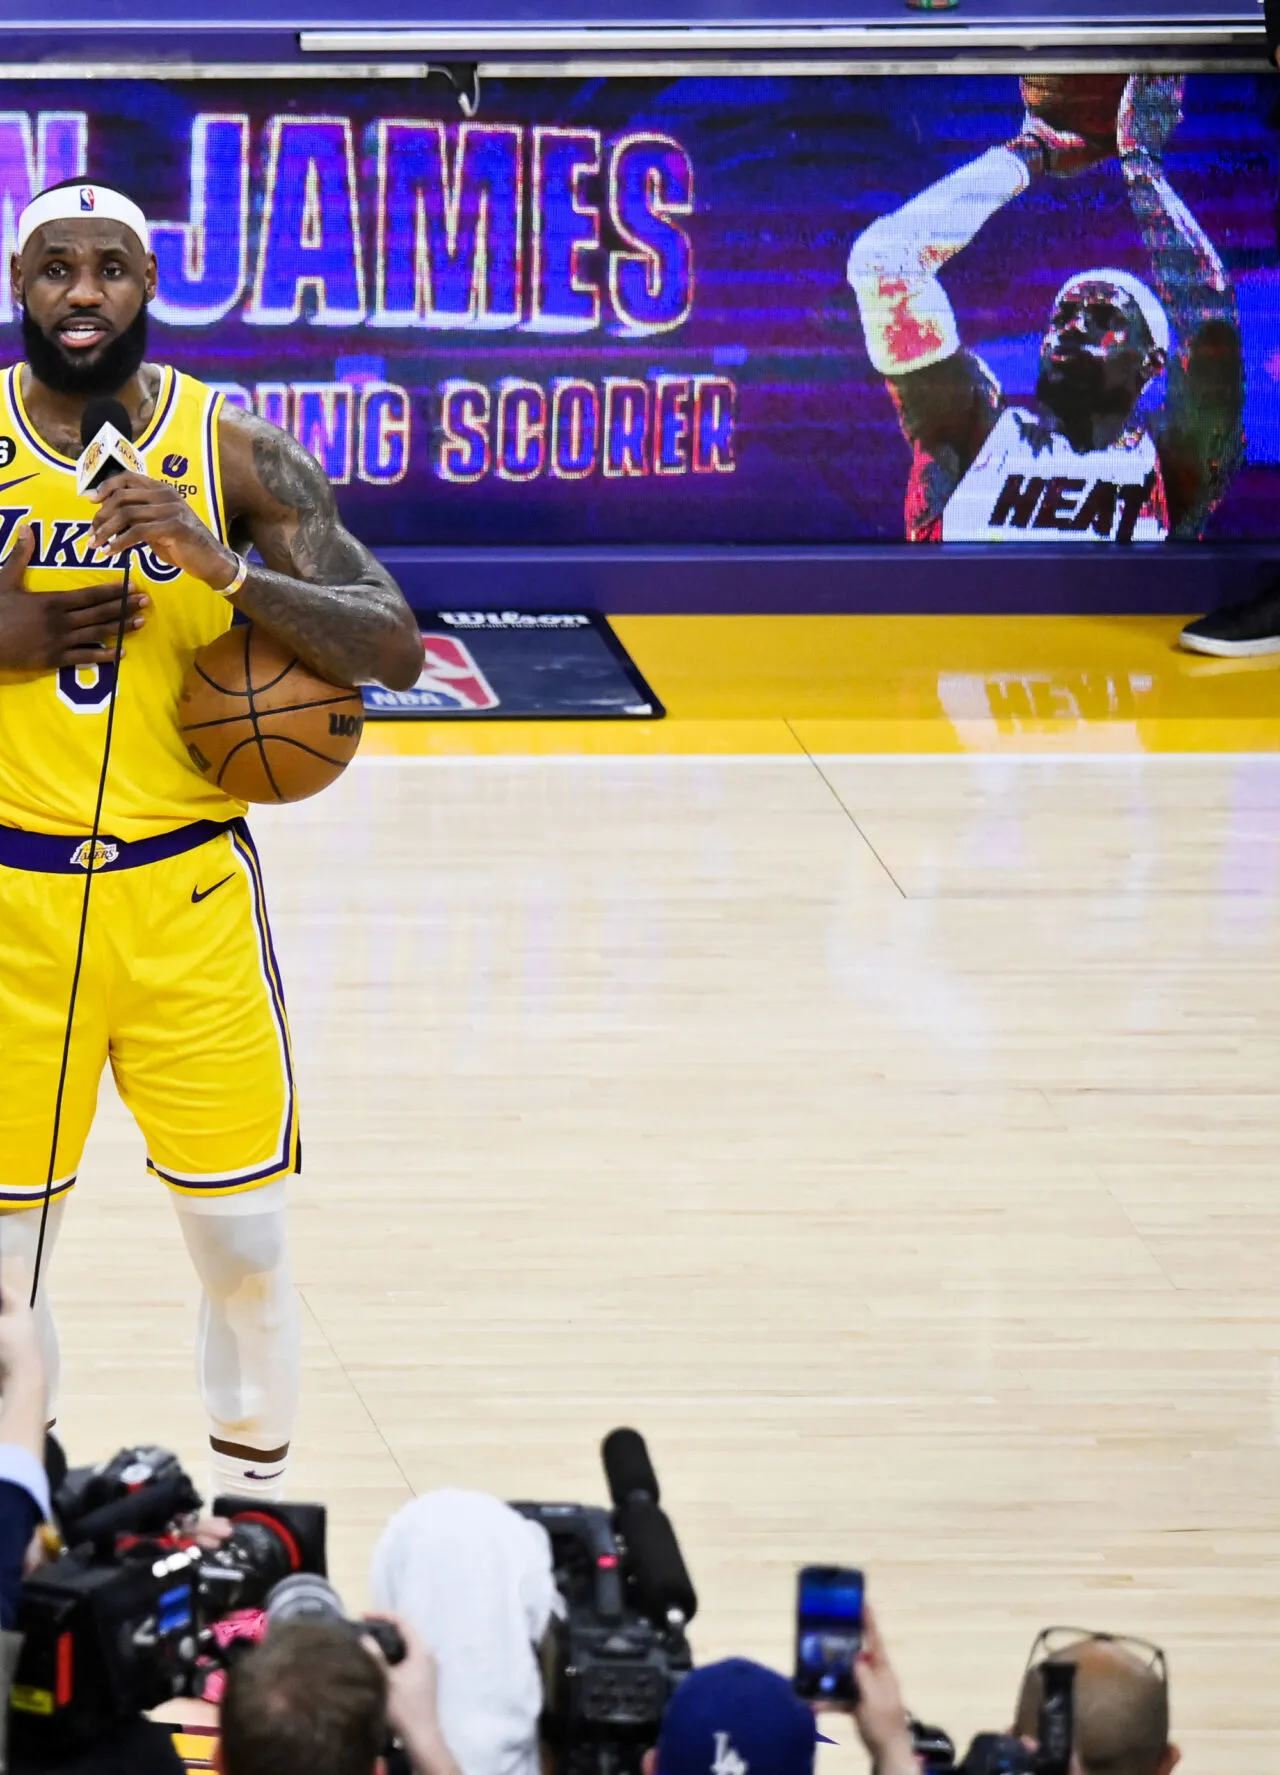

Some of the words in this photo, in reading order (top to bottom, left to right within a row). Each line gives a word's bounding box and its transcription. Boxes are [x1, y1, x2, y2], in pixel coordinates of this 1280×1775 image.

[146, 113, 695, 338] JAMES
[437, 374, 737, 483] SCORER
[987, 473, 1154, 541] HEAT
[437, 610, 592, 625] Wilson
[371, 691, 442, 706] NBA
